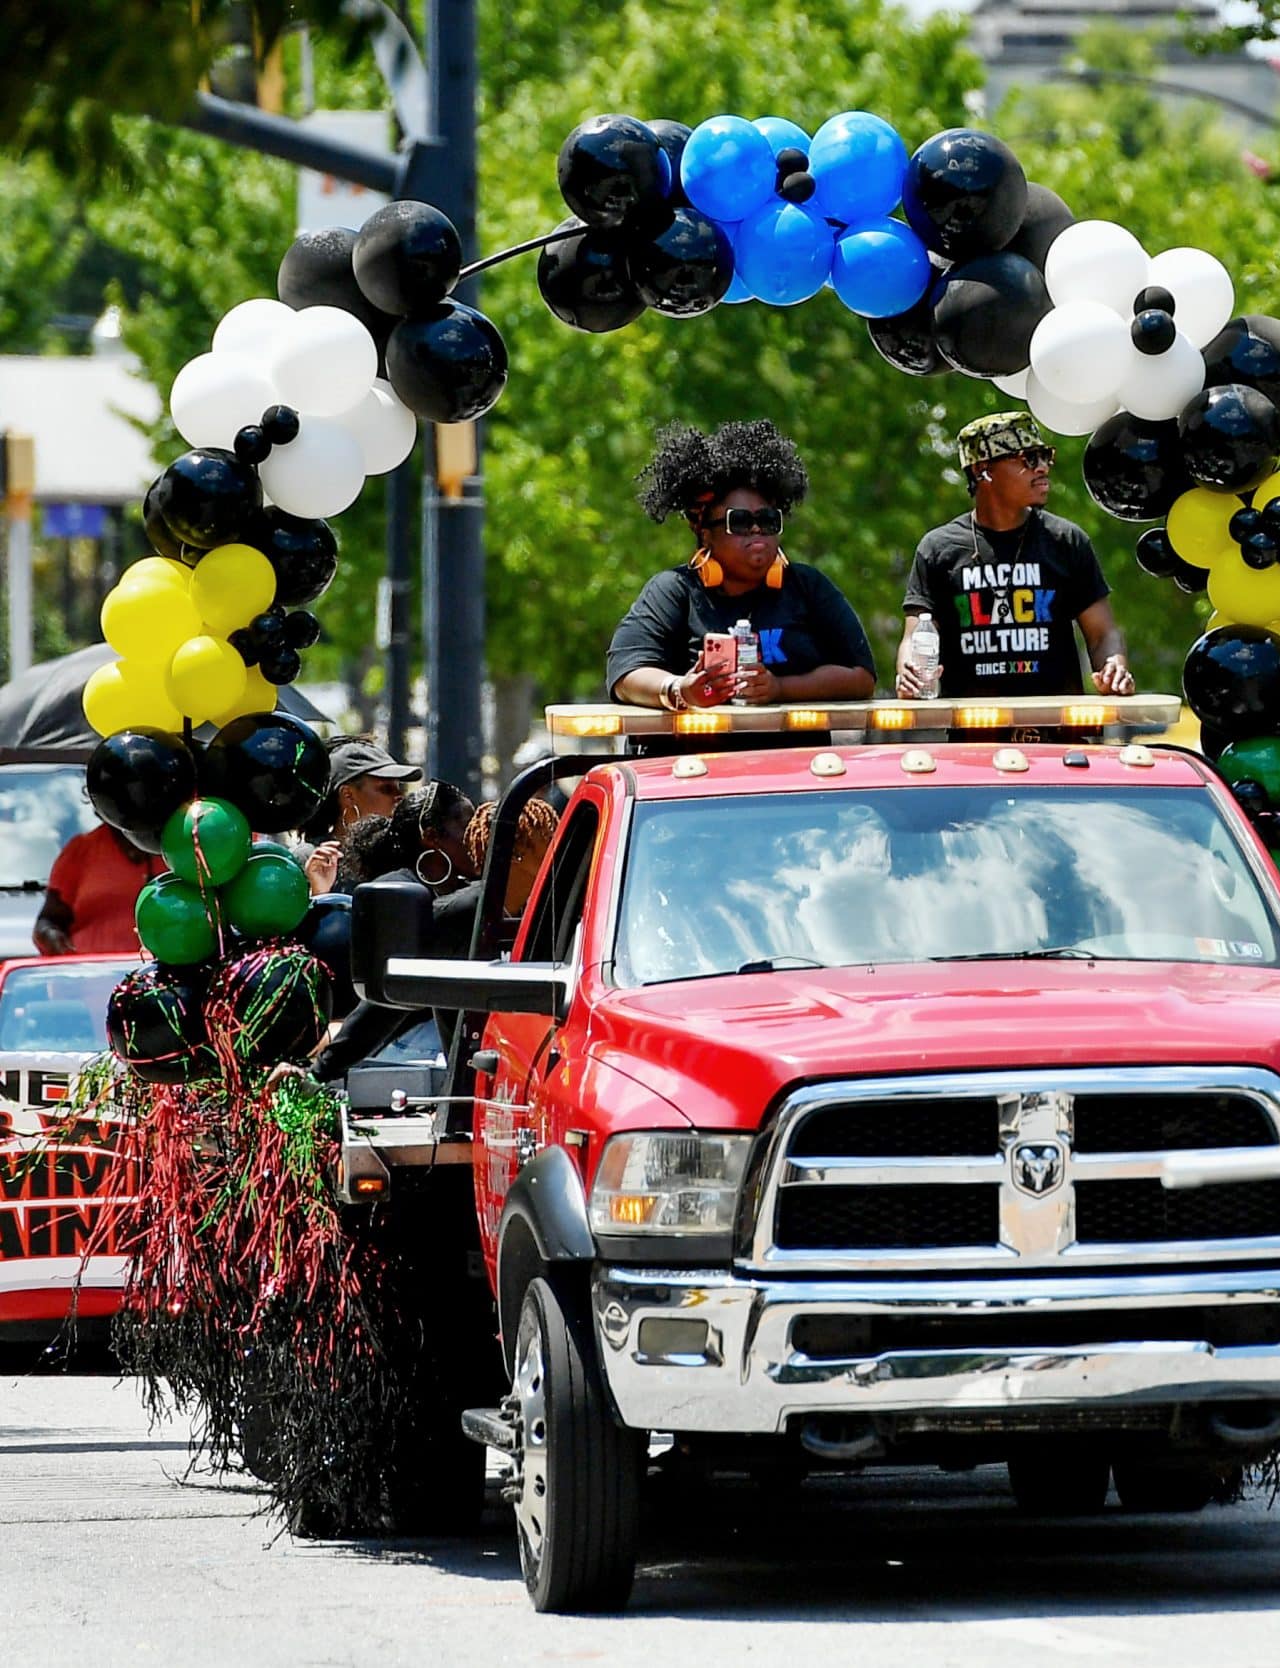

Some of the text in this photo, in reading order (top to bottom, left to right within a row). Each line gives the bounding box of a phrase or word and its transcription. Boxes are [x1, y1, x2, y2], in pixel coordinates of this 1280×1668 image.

[962, 562, 1041, 591] MACON
[960, 627, 1050, 655] CULTURE
[975, 660, 1039, 676] SINCE XXXX
